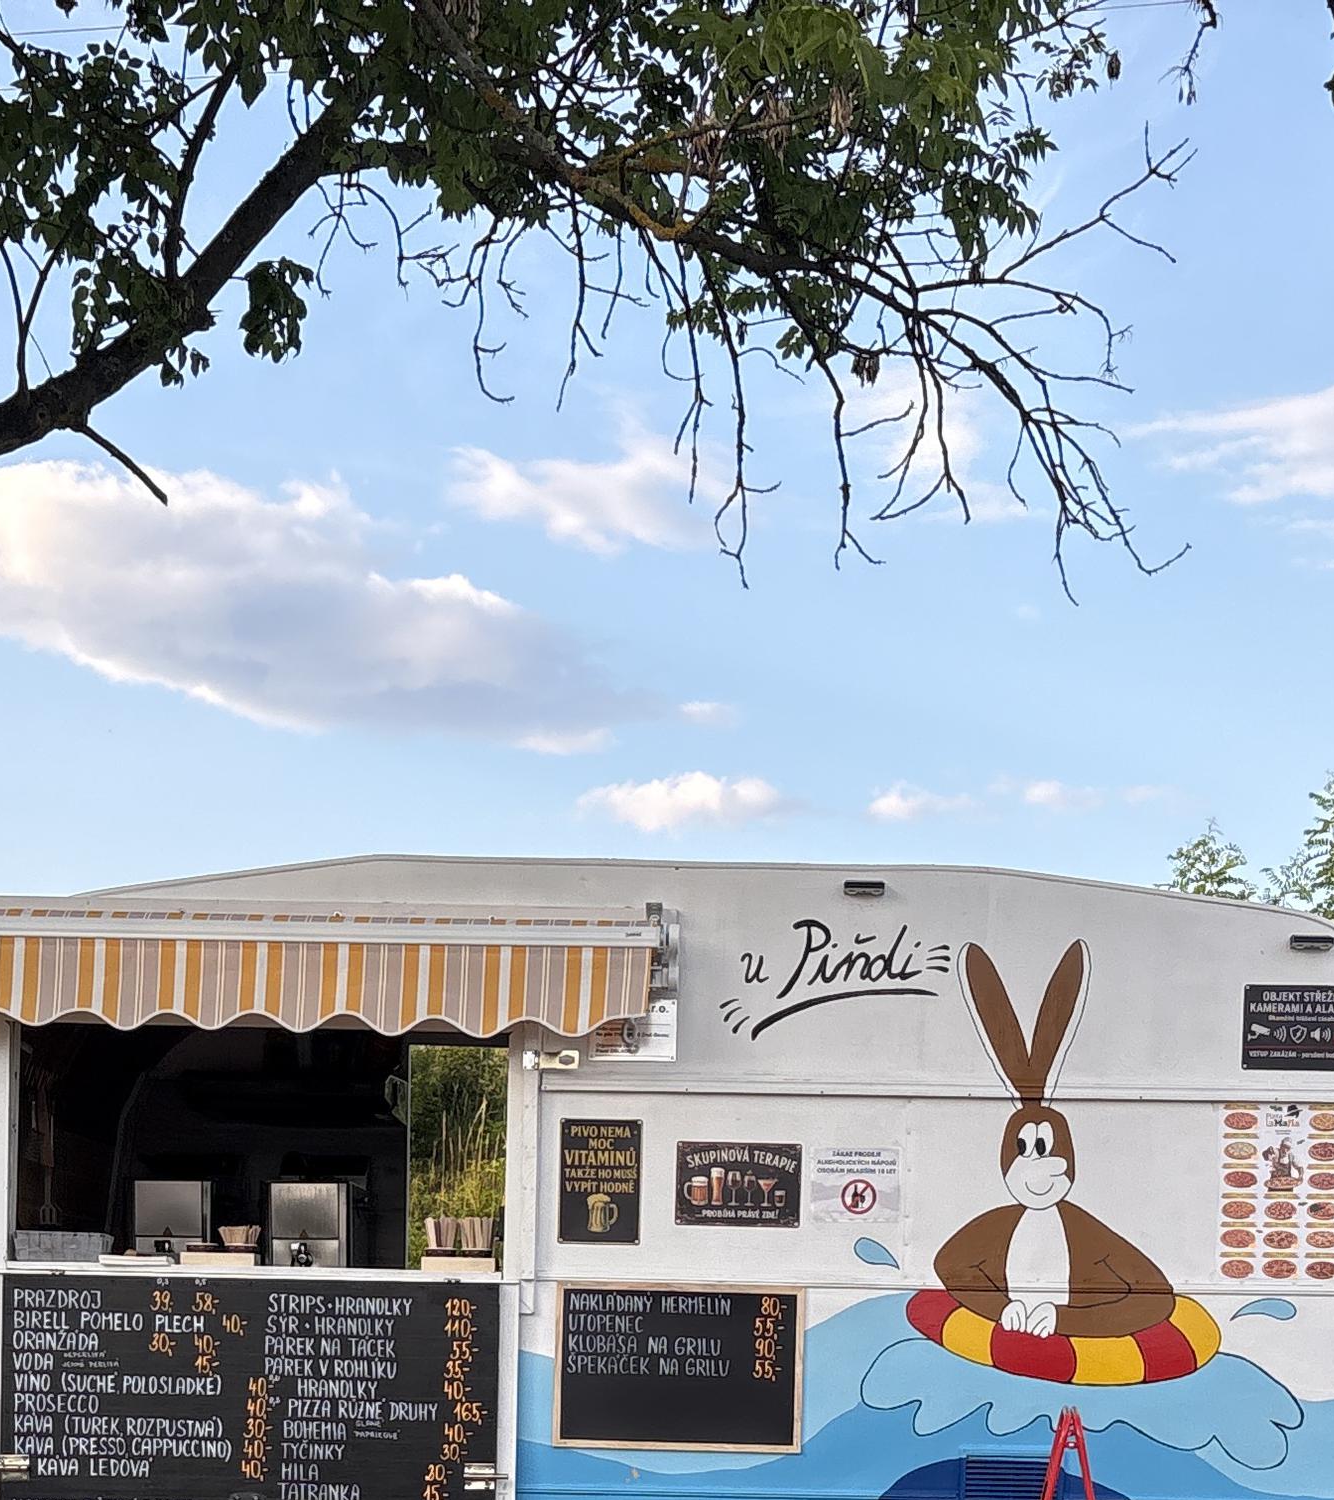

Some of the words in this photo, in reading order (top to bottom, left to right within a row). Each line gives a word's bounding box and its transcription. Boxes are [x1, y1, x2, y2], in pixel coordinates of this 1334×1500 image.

[741, 952, 769, 983] u
[776, 919, 922, 999] Piňdi
[1262, 991, 1302, 1002] OBJEKT
[1249, 1002, 1304, 1014] KAMERAMI
[1305, 1003, 1313, 1014] A
[570, 1125, 598, 1137] PIVO
[588, 1138, 615, 1150] MOC
[686, 1145, 750, 1168] SKUPINOVÁ
[753, 1150, 798, 1174] TERAPIE
[564, 1166, 597, 1178] TAKŽE
[598, 1168, 612, 1179] HO
[565, 1179, 598, 1192] VYPÍT
[599, 1180, 635, 1193] HODNĚ
[13, 1288, 101, 1309] PRAZDROJ
[268, 1293, 326, 1314] STRIPS
[335, 1296, 412, 1316] HRANOLKY
[569, 1291, 653, 1313] NAKLÁDANÝ
[661, 1294, 731, 1316] HERMELÍN
[14, 1310, 70, 1329] BIRELL
[81, 1312, 143, 1331] POMELO
[155, 1314, 204, 1333] PLECH
[265, 1313, 299, 1335] SÝR
[314, 1315, 394, 1337] HRANOLKY
[568, 1314, 644, 1333] UTOPENEC
[13, 1329, 98, 1351] ORANŽÁDA
[265, 1333, 315, 1356] PÁREK
[320, 1337, 341, 1356] NA
[568, 1332, 637, 1354] KLOBÁSA
[647, 1336, 667, 1355] NA
[674, 1337, 722, 1356] GRILU
[13, 1352, 53, 1370] VODA
[265, 1355, 313, 1377] PÁREK
[319, 1359, 329, 1377] V
[334, 1357, 397, 1379] ROHLÍKU
[567, 1352, 650, 1375] ŠPEKÁČEK
[658, 1358, 679, 1376] NA
[685, 1358, 730, 1377] GRILU
[14, 1370, 51, 1392] VÍNO
[297, 1378, 378, 1400] HRANOLKY
[14, 1393, 99, 1414] PROSECCO
[288, 1398, 331, 1418] PIZZA
[389, 1401, 438, 1421] DRUHY
[14, 1411, 53, 1433] KÁVA
[283, 1420, 347, 1441] BOHEMIA
[14, 1434, 54, 1455] KÁVA
[132, 1437, 232, 1462] CAPPUCCINO)
[281, 1440, 345, 1460] TYČINKY
[37, 1455, 79, 1476] KÁVA
[90, 1457, 153, 1478] LEDOVÁ
[281, 1462, 319, 1481] MILA
